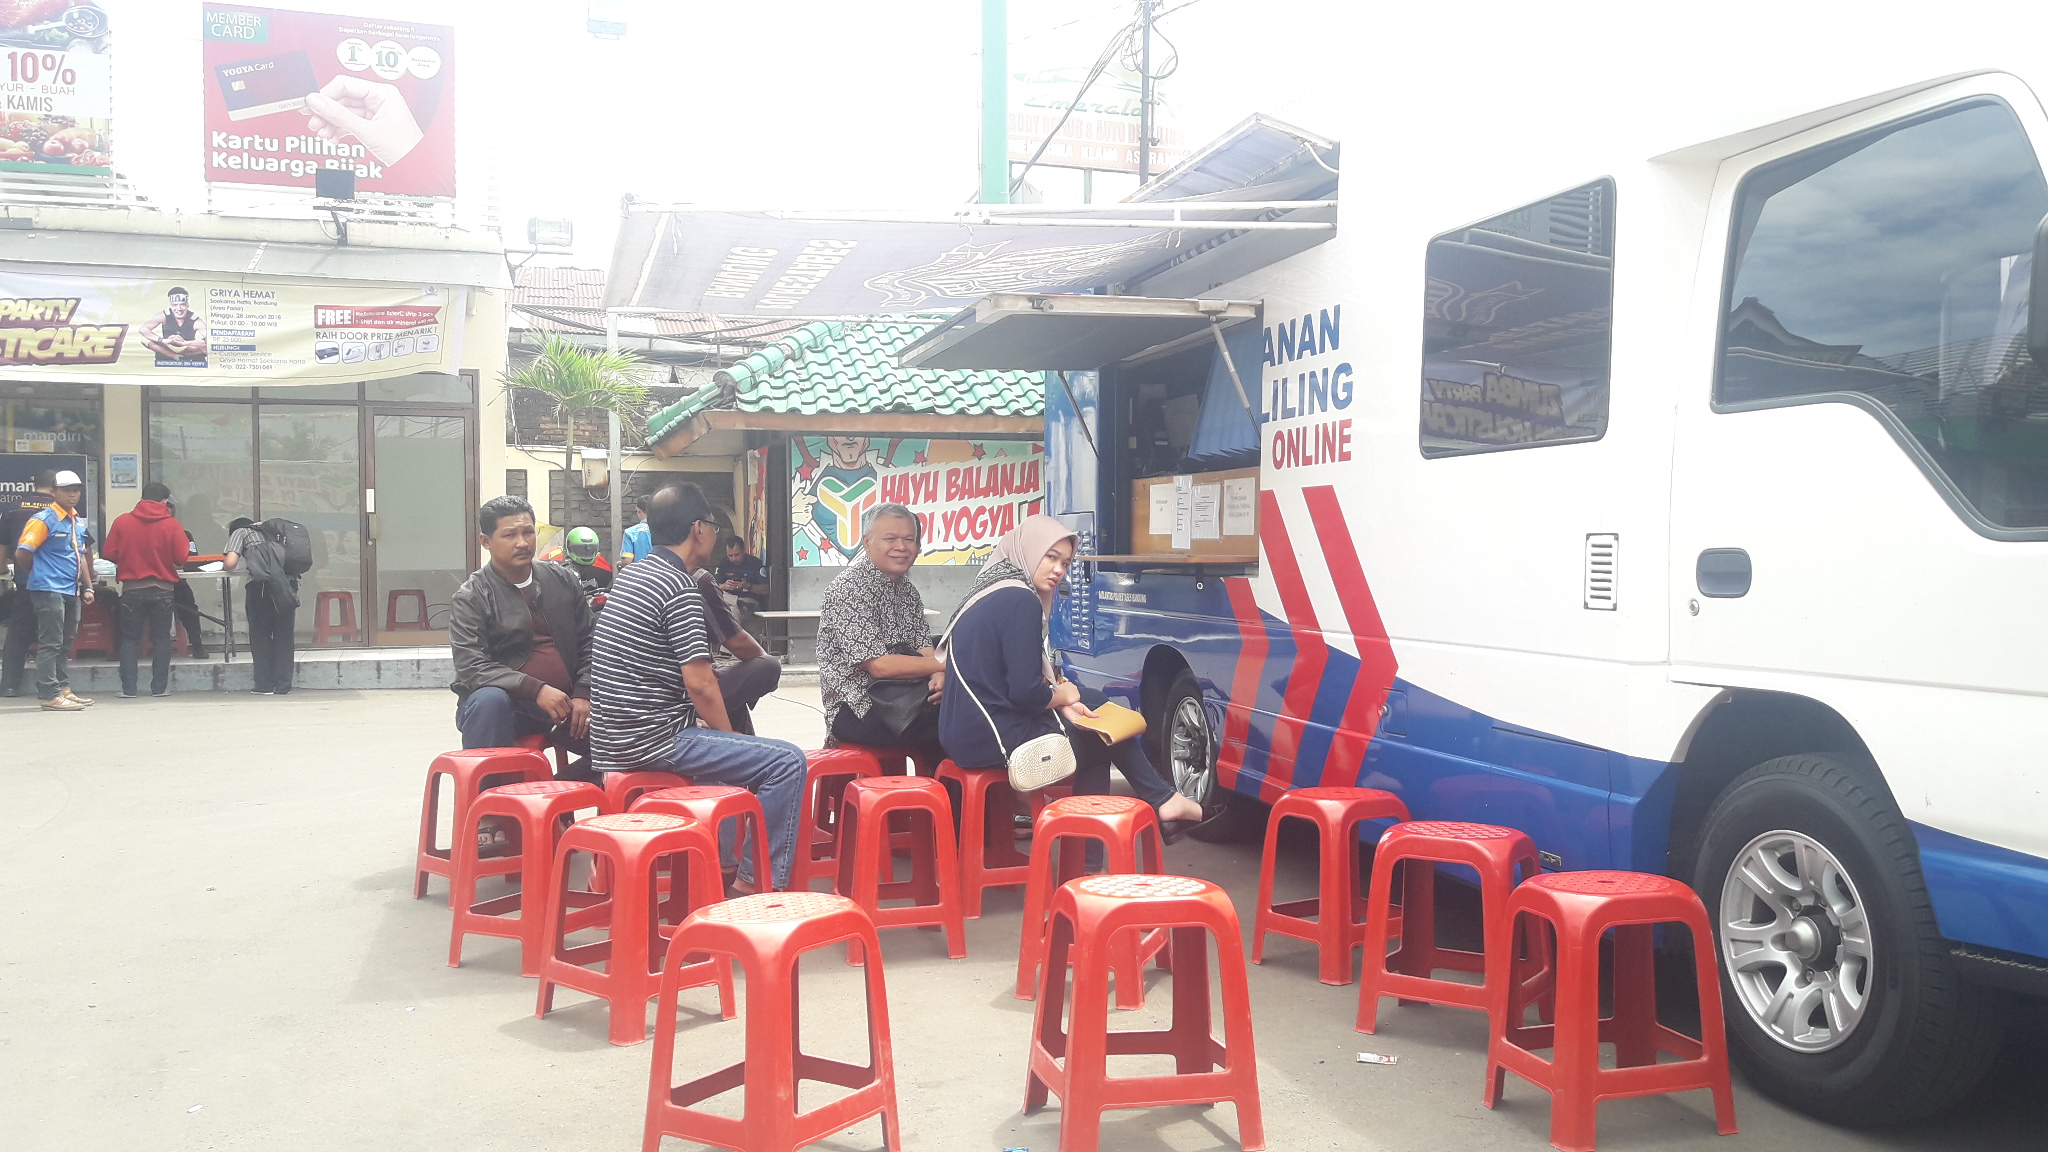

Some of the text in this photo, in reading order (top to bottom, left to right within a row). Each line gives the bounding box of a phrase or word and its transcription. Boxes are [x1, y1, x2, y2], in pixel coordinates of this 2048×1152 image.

[207, 12, 262, 27] MEMBER
[212, 24, 256, 39] CARD
[8, 52, 76, 85] 10%
[223, 62, 274, 77] YOGYA Card
[42, 85, 75, 95] BUAH
[7, 95, 53, 112] KAMIS
[212, 131, 366, 158] Kartu Pilihan
[212, 151, 319, 178] Keluarga
[210, 288, 276, 299] GRIYA HEMAT
[0, 299, 78, 321] PARTY
[318, 309, 352, 326] FREE
[0, 326, 123, 359] TICARE
[316, 331, 338, 340] RAIH
[340, 332, 368, 341] DOOR
[371, 332, 393, 341] PRIZE
[395, 328, 433, 338] MENARIK
[1262, 304, 1340, 367] ANAN
[24, 430, 81, 441] mandiri
[1272, 418, 1352, 470] ONLINE
[881, 458, 1041, 507] HAYU BALANJA
[941, 502, 1015, 543] YOGYA
